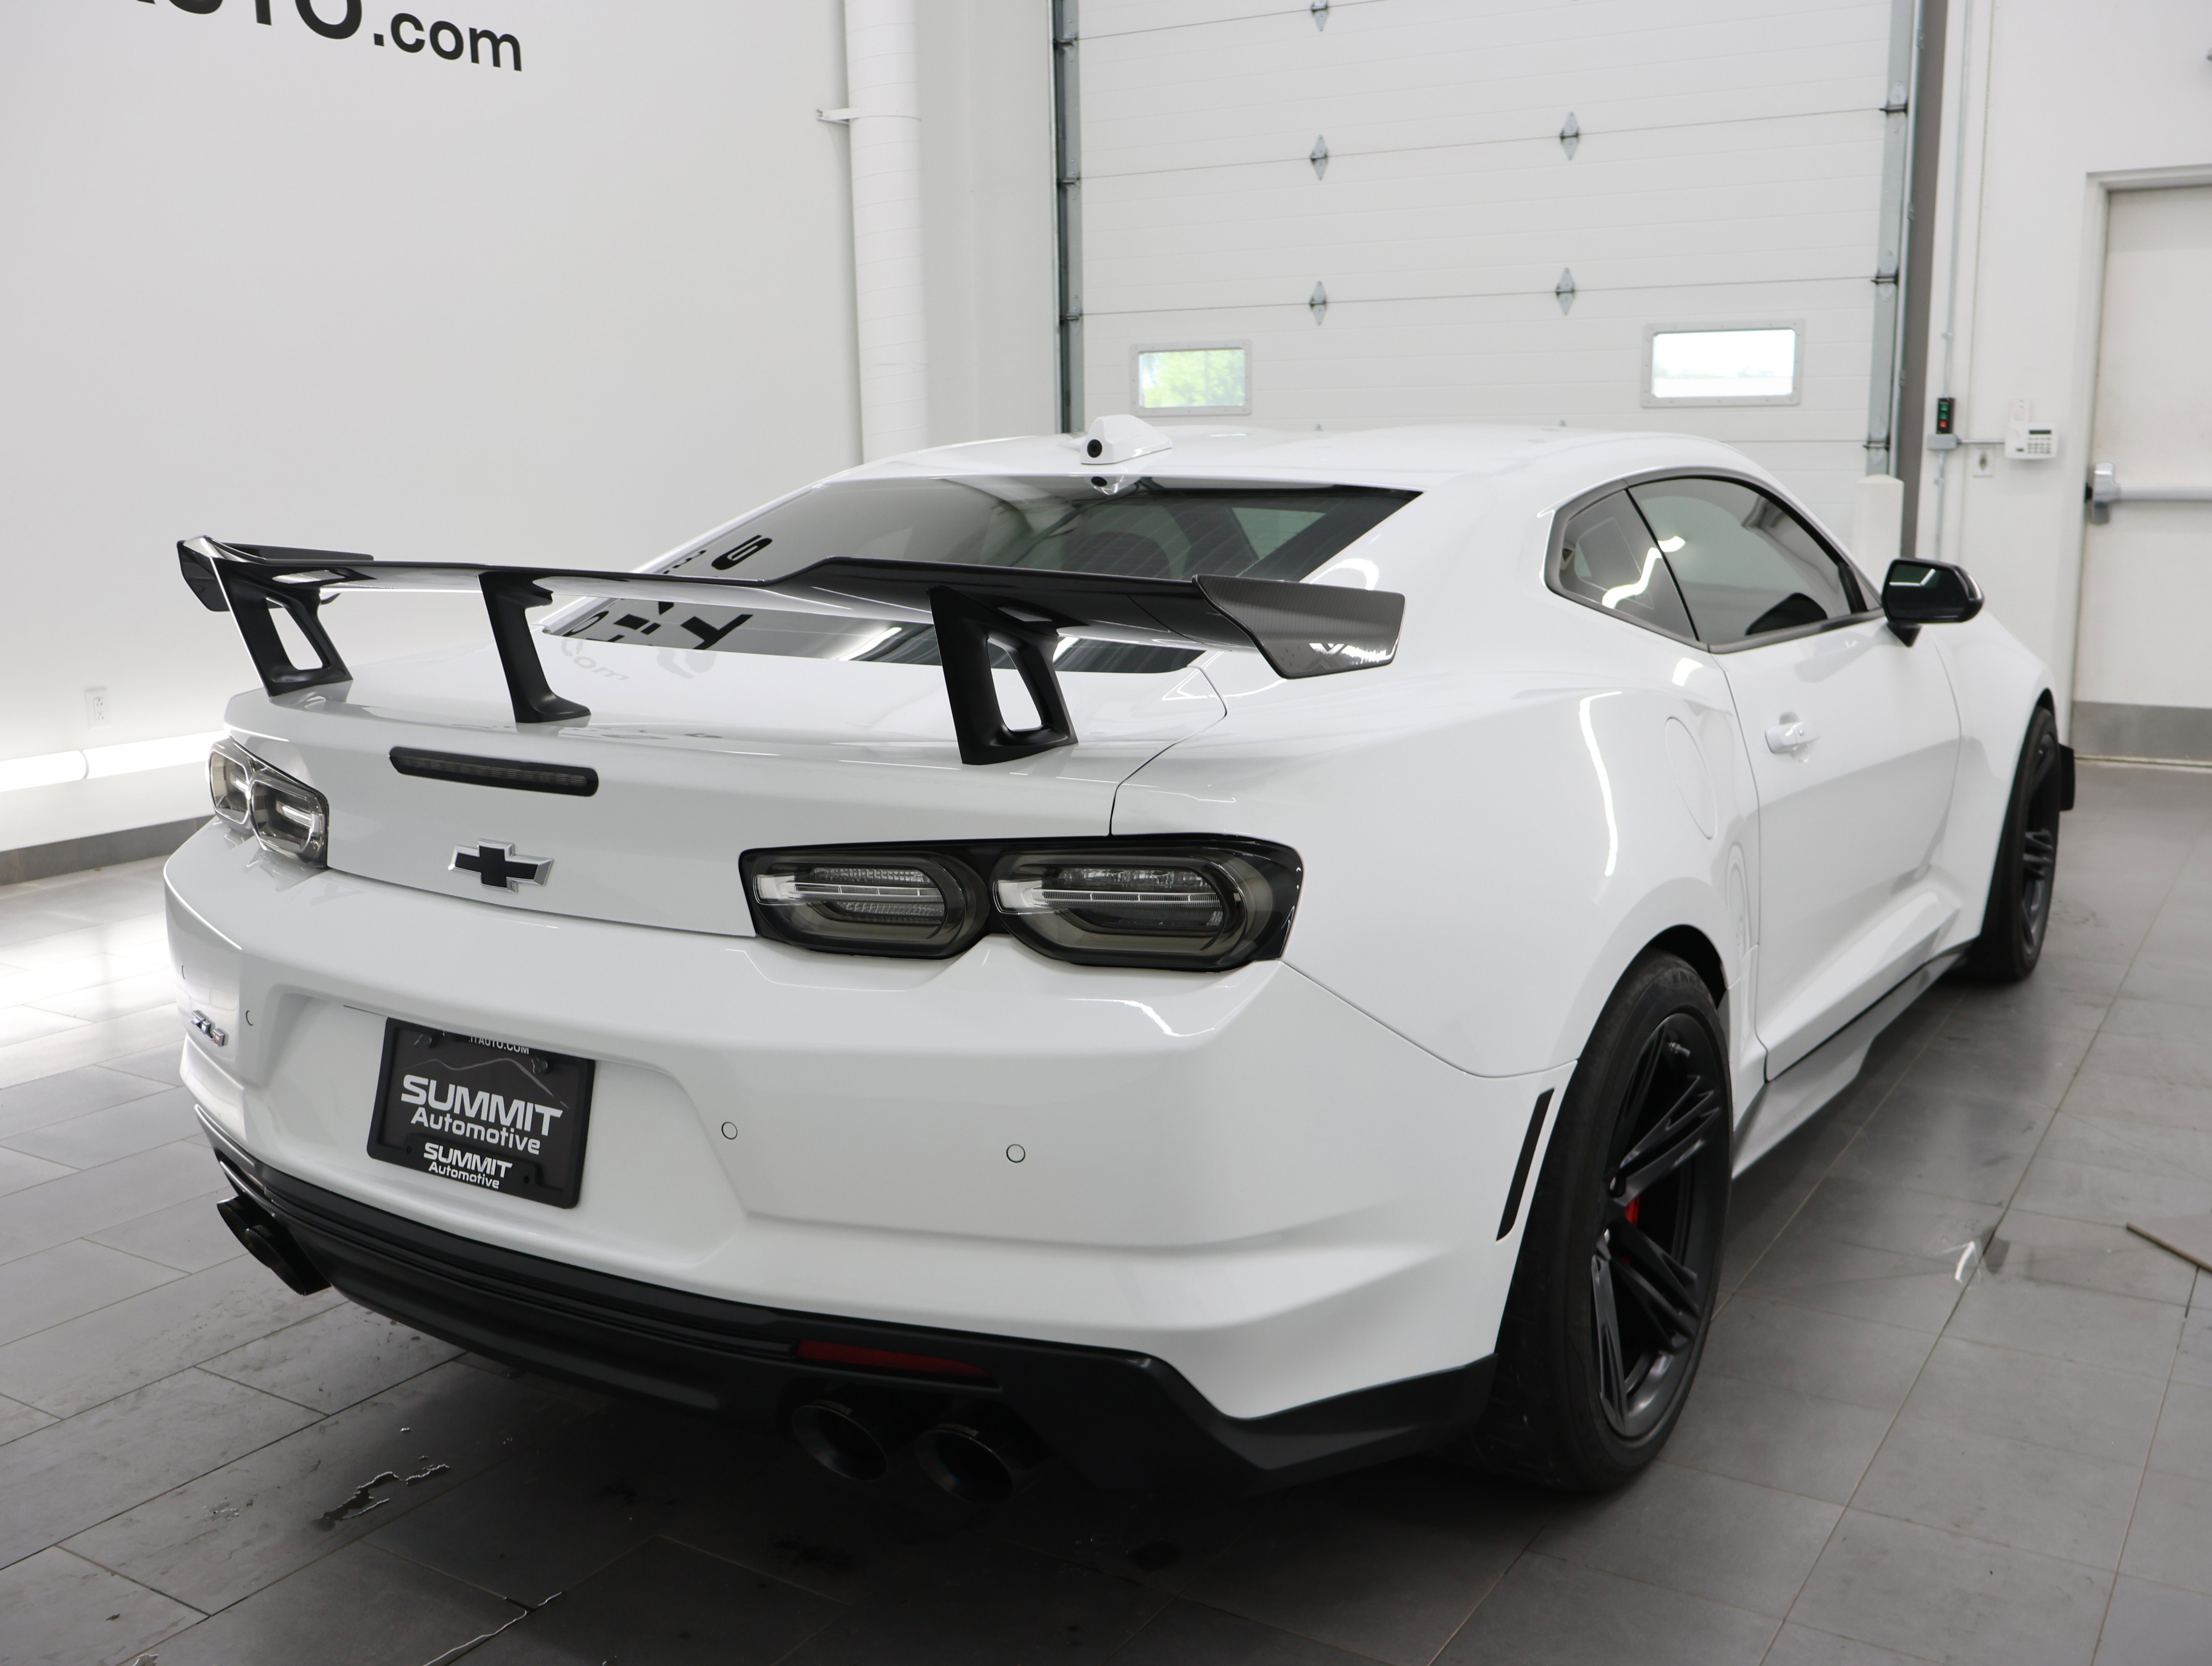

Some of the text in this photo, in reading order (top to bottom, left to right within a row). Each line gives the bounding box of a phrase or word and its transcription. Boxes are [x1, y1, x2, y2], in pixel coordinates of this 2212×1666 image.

[401, 1074, 563, 1136] SUMMIT
[410, 1106, 540, 1155] Automotive
[424, 1142, 513, 1178] SUMMIT
[428, 1161, 499, 1189] Automotive
